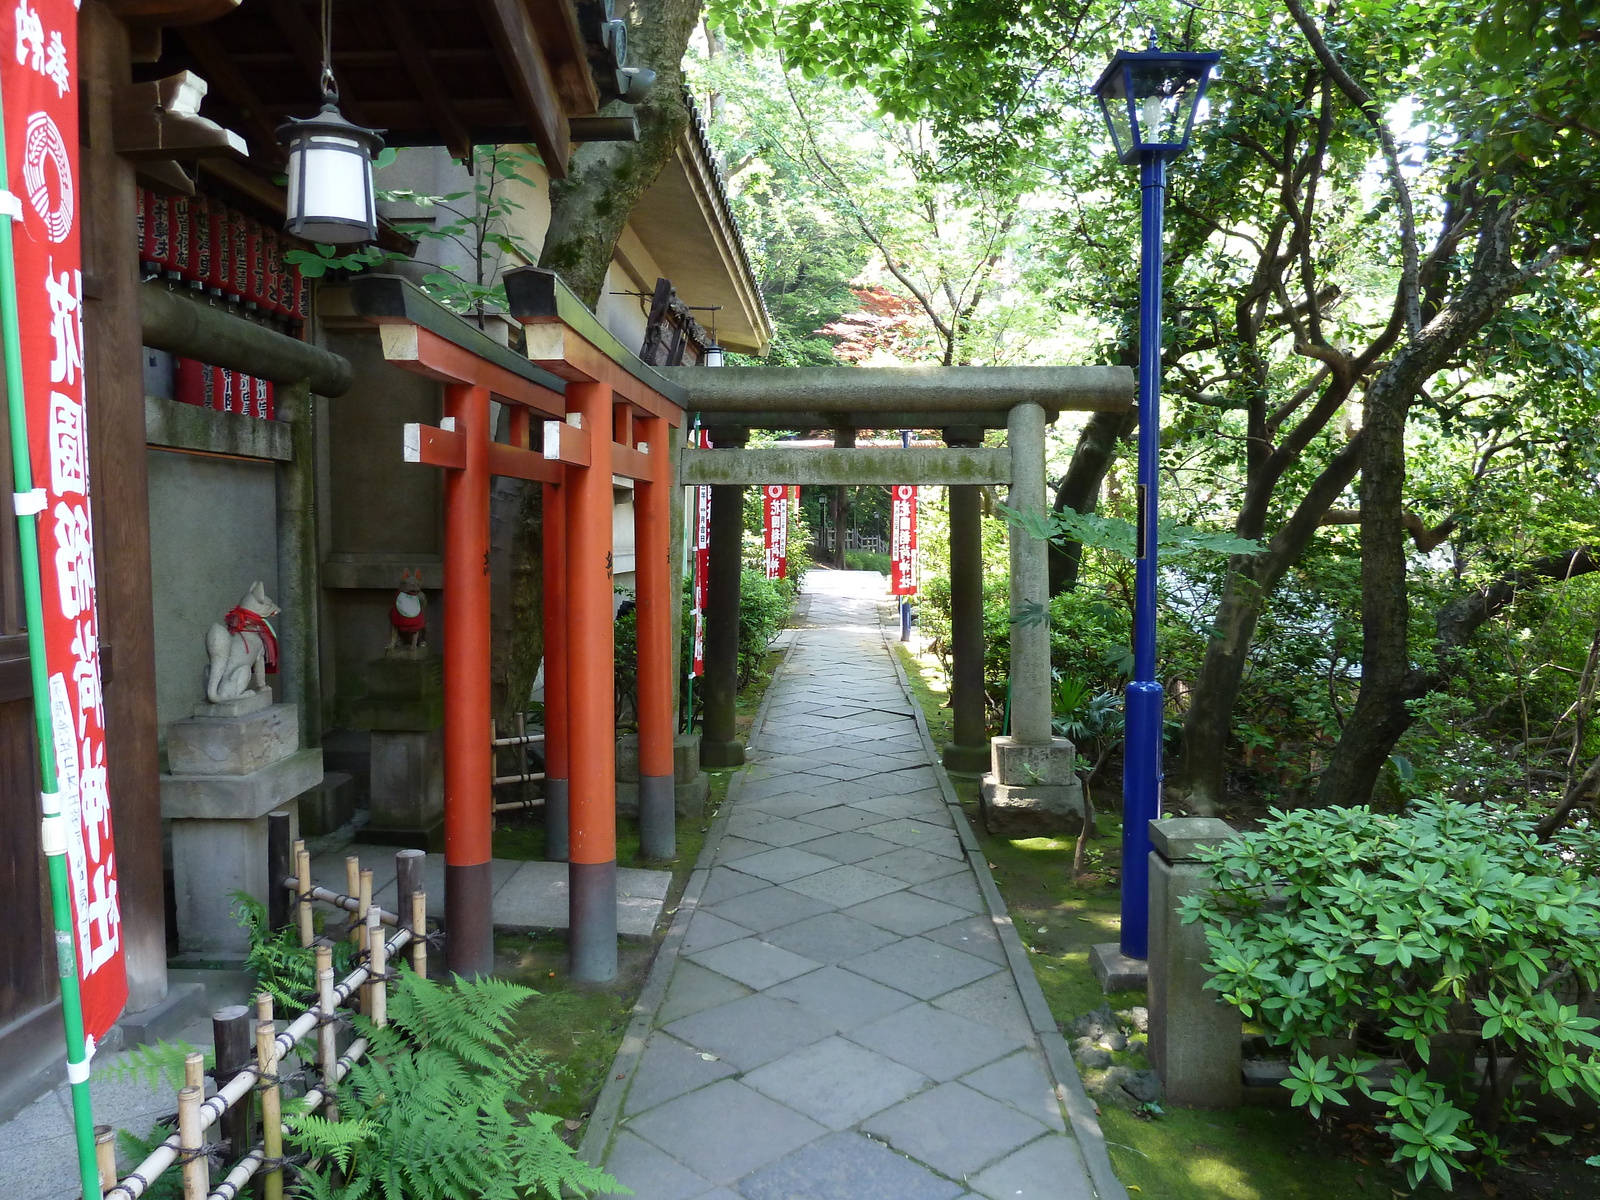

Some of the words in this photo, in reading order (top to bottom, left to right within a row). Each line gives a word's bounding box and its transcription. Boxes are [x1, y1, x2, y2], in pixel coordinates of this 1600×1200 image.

[898, 499, 911, 589] 花園稲荷神社
